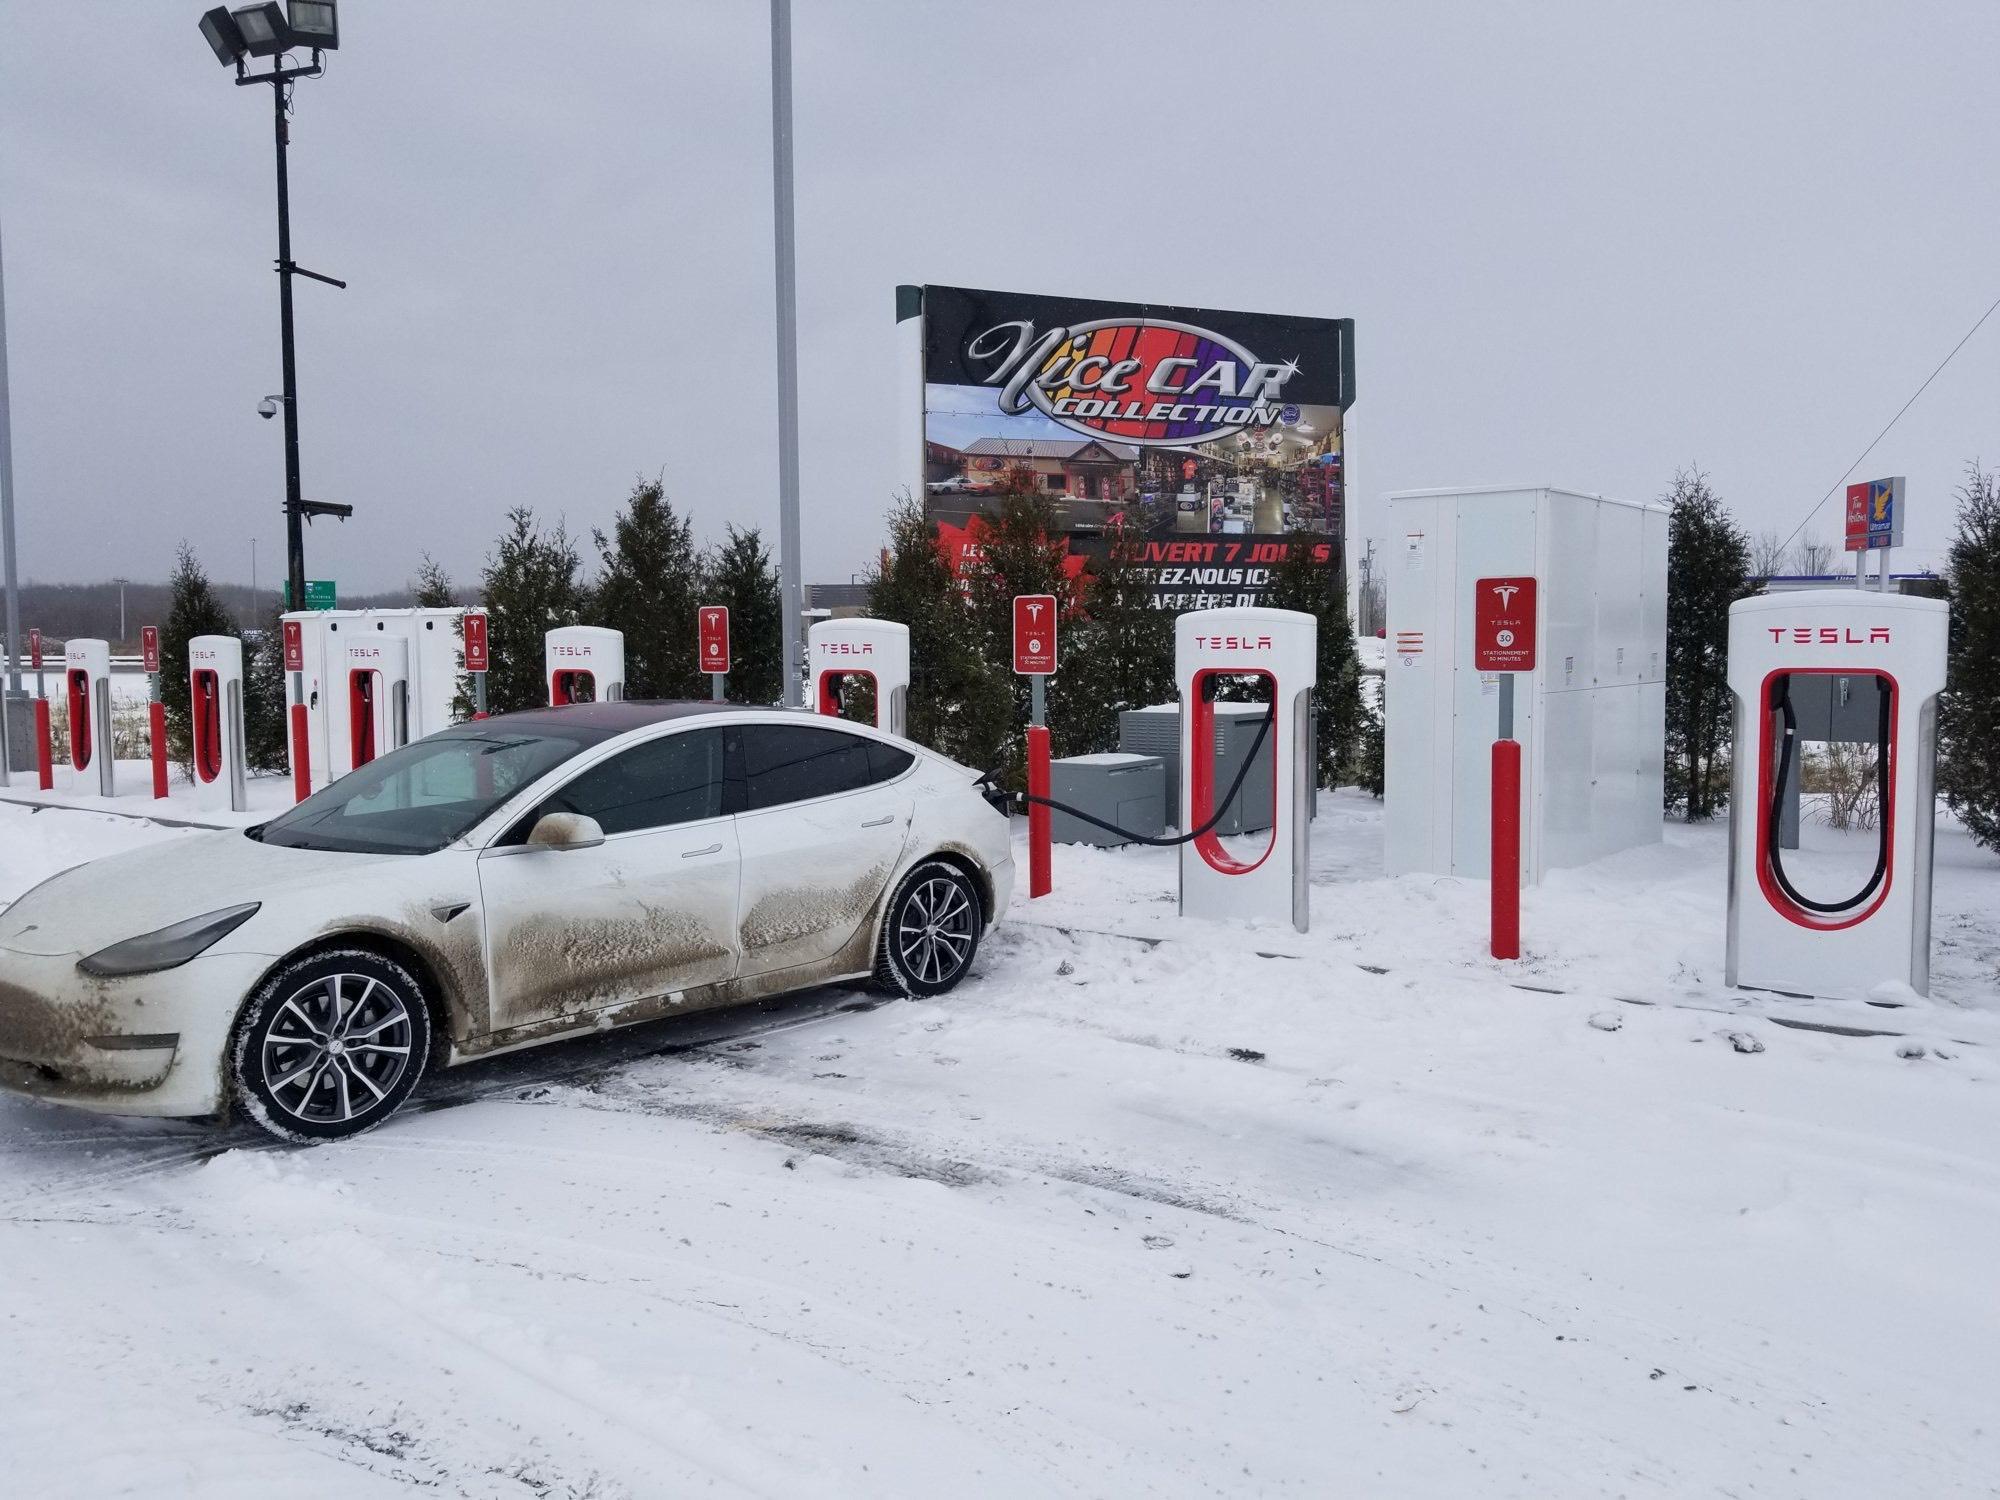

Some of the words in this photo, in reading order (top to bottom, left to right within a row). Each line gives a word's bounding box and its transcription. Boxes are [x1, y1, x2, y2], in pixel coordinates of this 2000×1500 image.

[968, 320, 1141, 415] Nice
[1147, 357, 1292, 399] CAR
[1051, 397, 1280, 425] COLLECTION
[1224, 543, 1242, 562] 7
[1244, 543, 1332, 563] JOS
[1500, 634, 1511, 642] 30
[1768, 628, 1890, 643] TESLA
[821, 644, 872, 654] TESLA
[1195, 637, 1271, 650] TESLA
[349, 648, 380, 657] TESLA
[552, 646, 591, 656] TESLA
